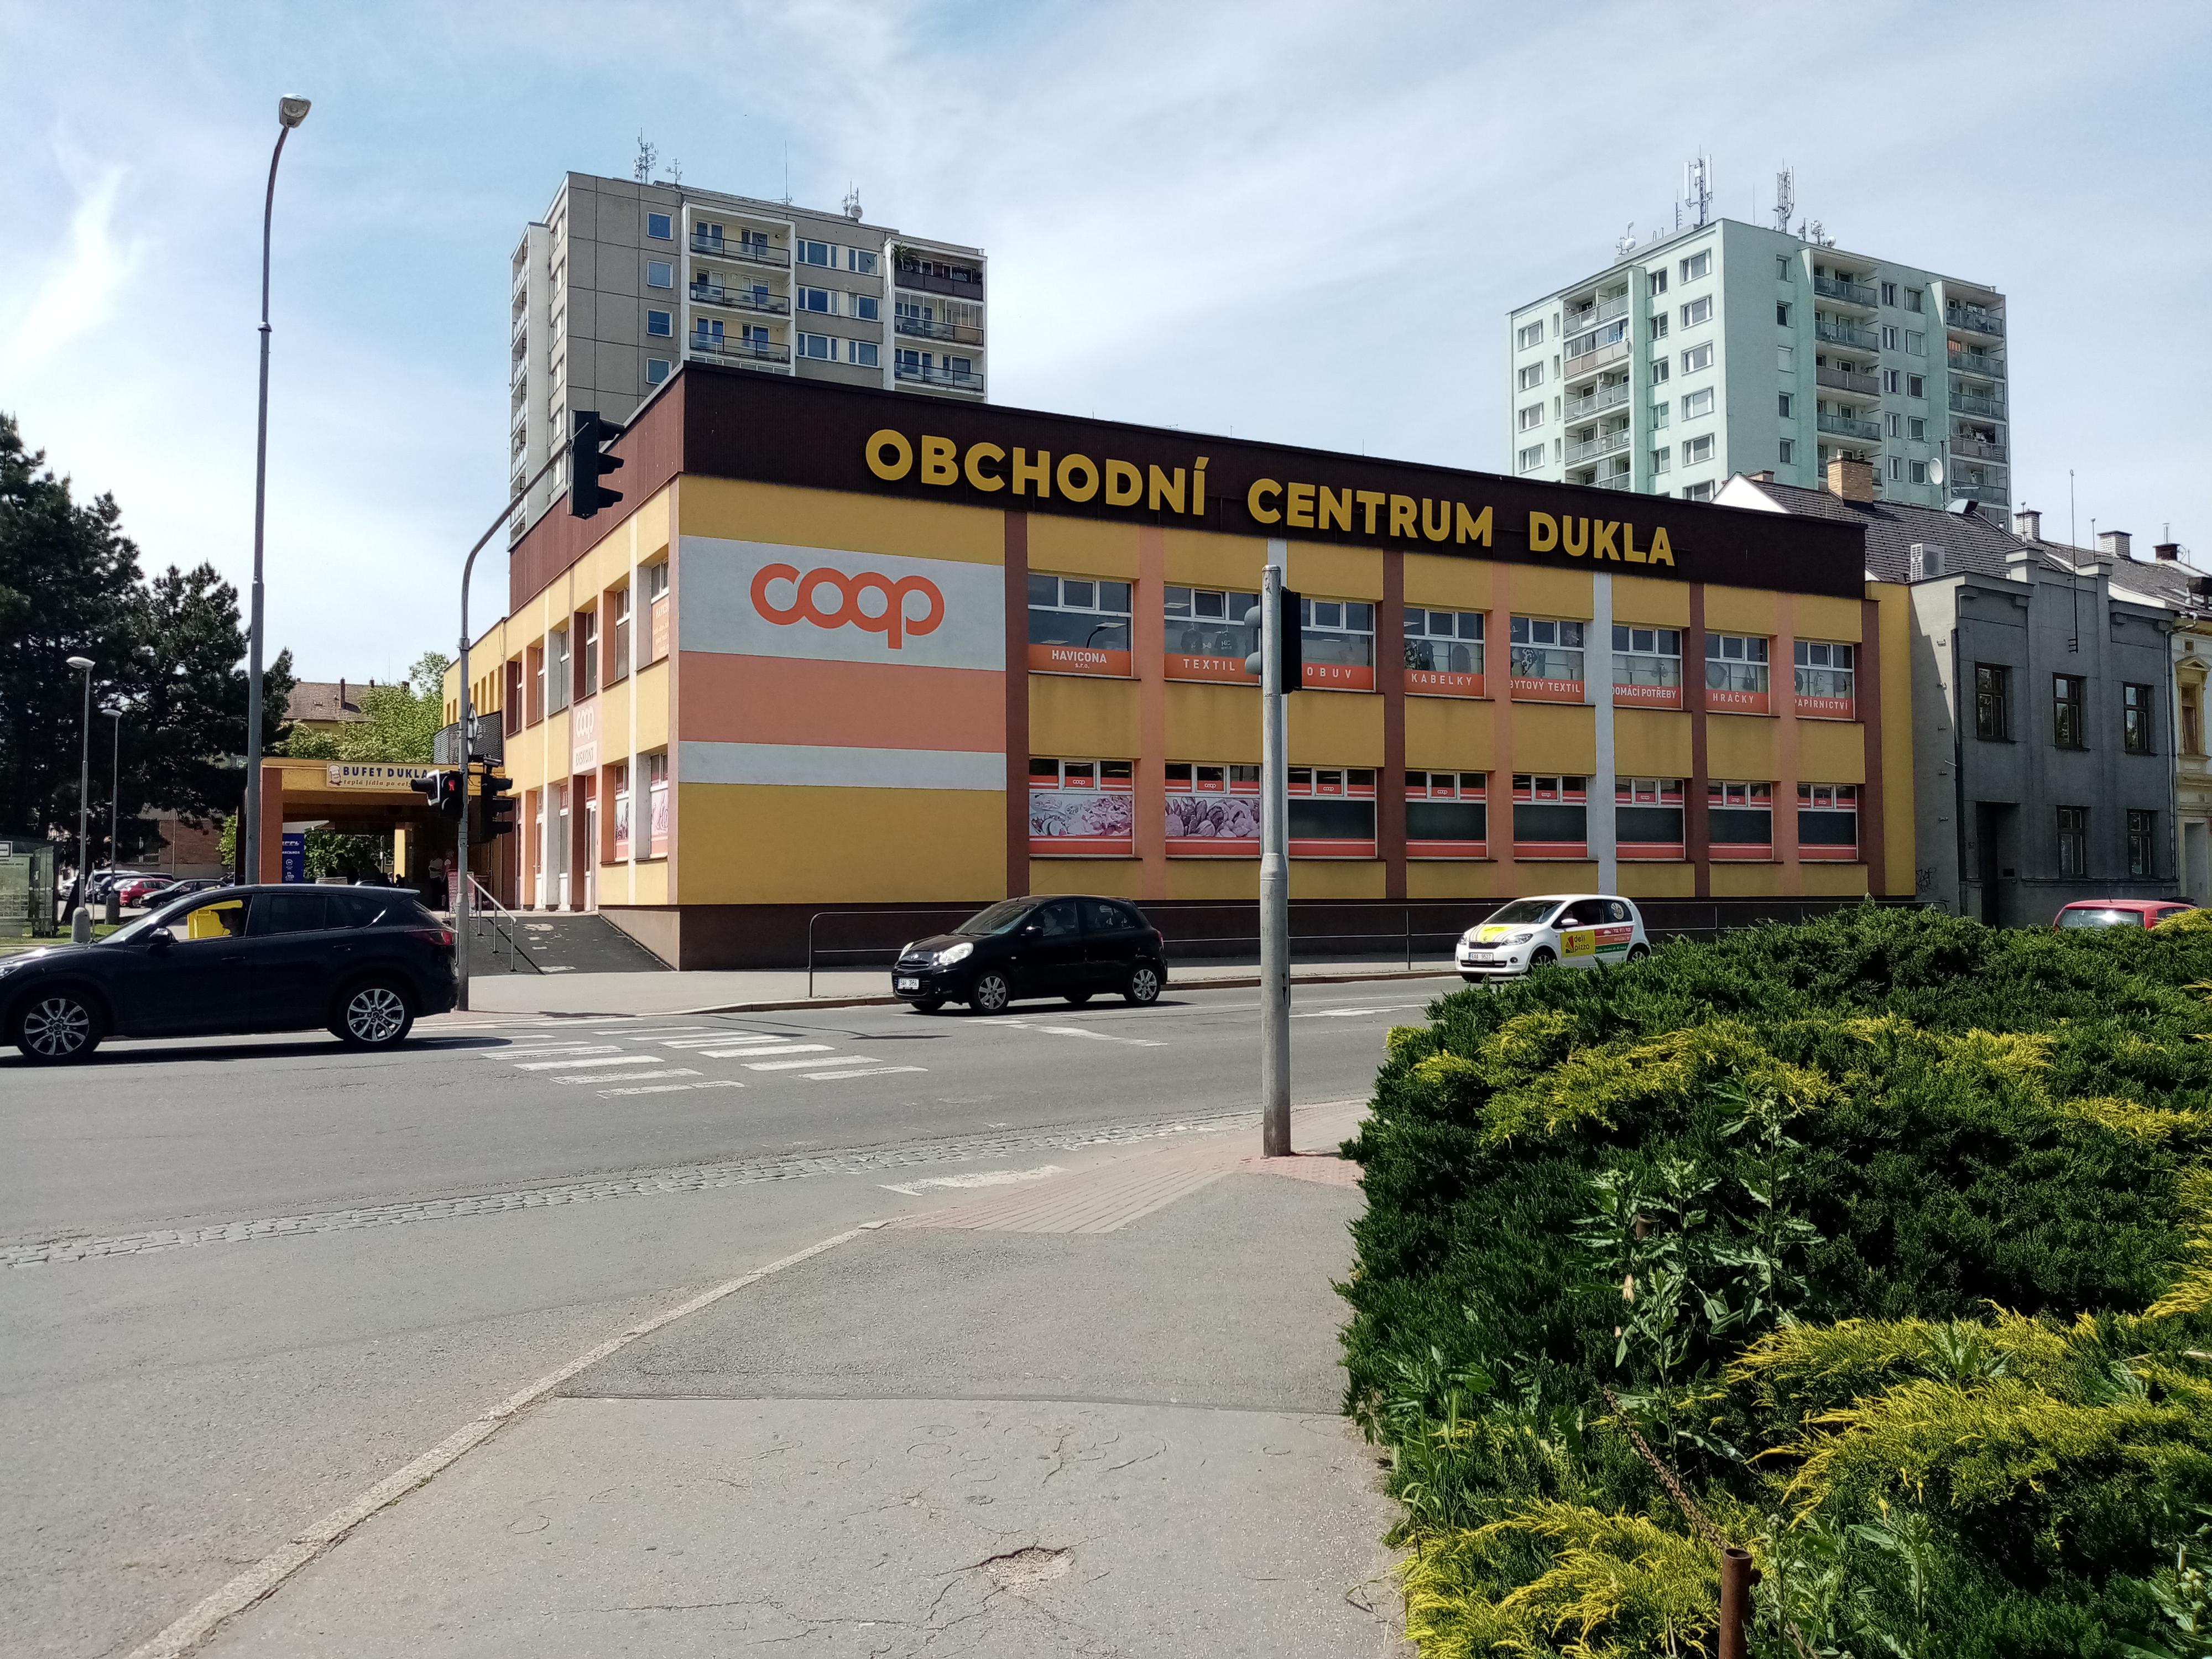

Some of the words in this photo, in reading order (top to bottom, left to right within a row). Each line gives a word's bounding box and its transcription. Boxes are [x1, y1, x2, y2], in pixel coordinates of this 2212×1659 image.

[865, 429, 1209, 515] OBCHODNÍ
[1248, 478, 1493, 547] CENTRUM
[1529, 512, 1674, 567] DUKLA
[750, 564, 945, 650] coop
[1052, 649, 1107, 664] HAVICONA
[1183, 658, 1235, 671] TEXTIL
[1307, 666, 1352, 679] OBUV
[1411, 673, 1472, 686] KABELKY
[1548, 682, 1581, 693] TEXTIL
[1612, 685, 1640, 697] DOMÁCÍ
[1641, 686, 1677, 698] POTŘEBY
[1713, 692, 1754, 704] HRAČKY
[576, 706, 594, 740] coop
[576, 747, 594, 766] DISKONT
[343, 766, 382, 777] BUFET
[387, 768, 427, 779] DUKLA
[1574, 944, 1590, 952] pizza
